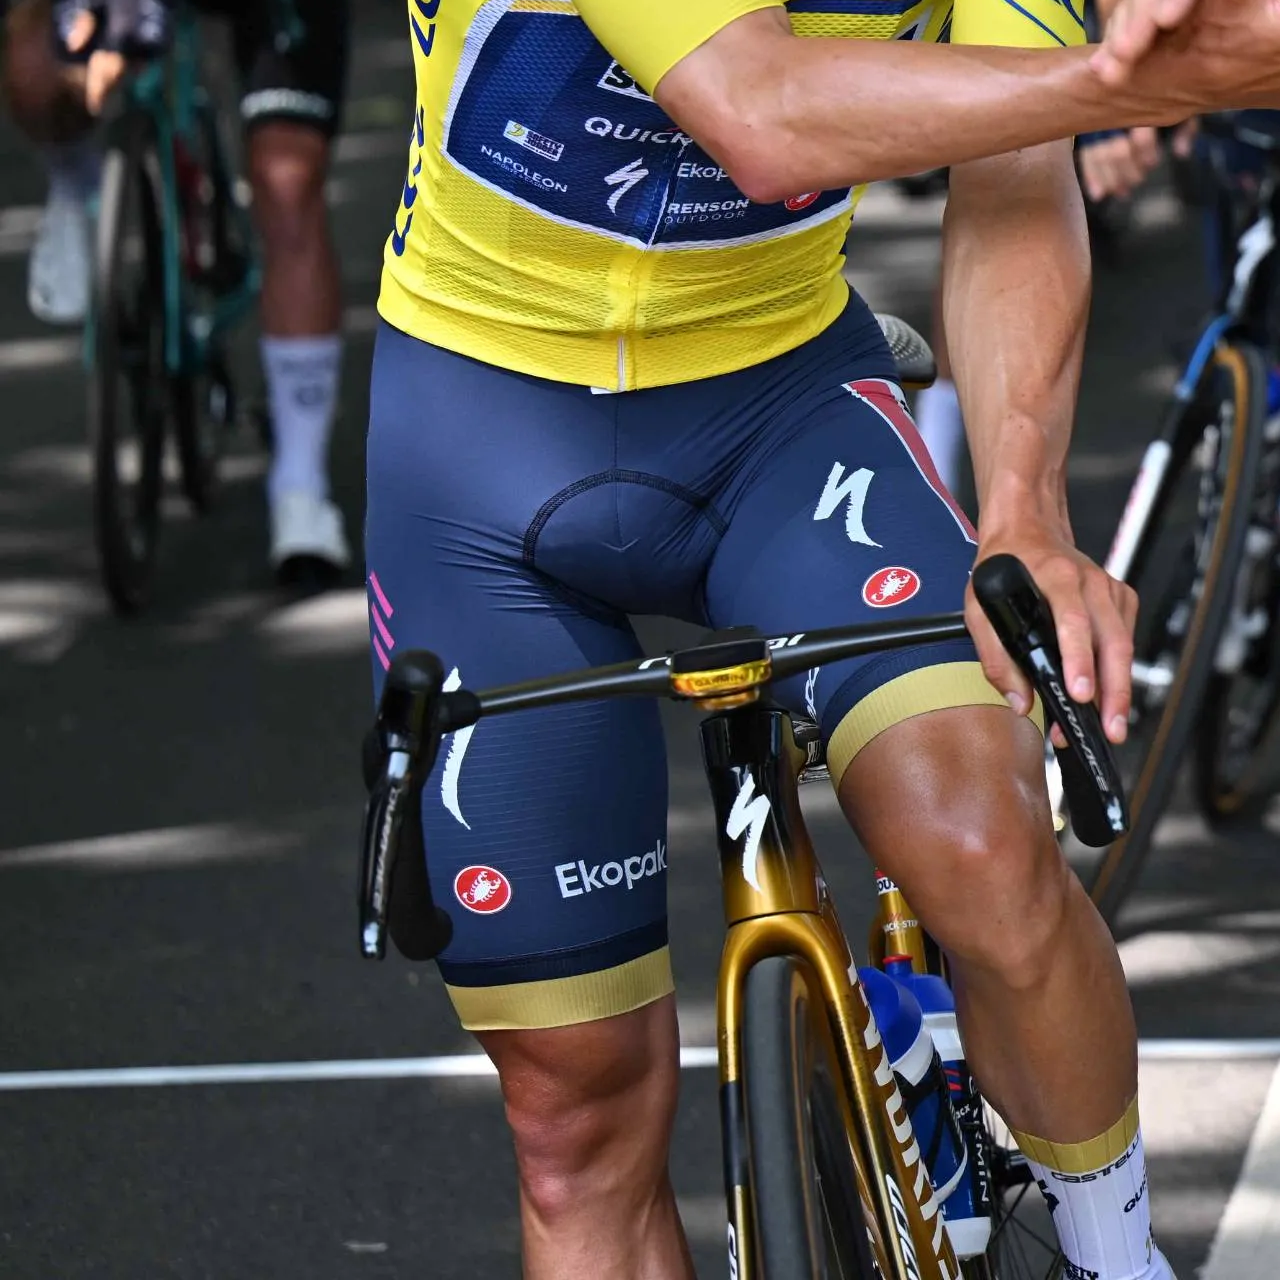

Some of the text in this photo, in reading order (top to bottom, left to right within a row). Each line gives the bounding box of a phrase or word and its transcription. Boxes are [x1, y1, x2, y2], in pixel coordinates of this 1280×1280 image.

[481, 144, 568, 193] NAPOLEON
[664, 211, 746, 225] OUTDOOR
[667, 199, 750, 215] RENSON
[555, 837, 668, 899] Ekopak
